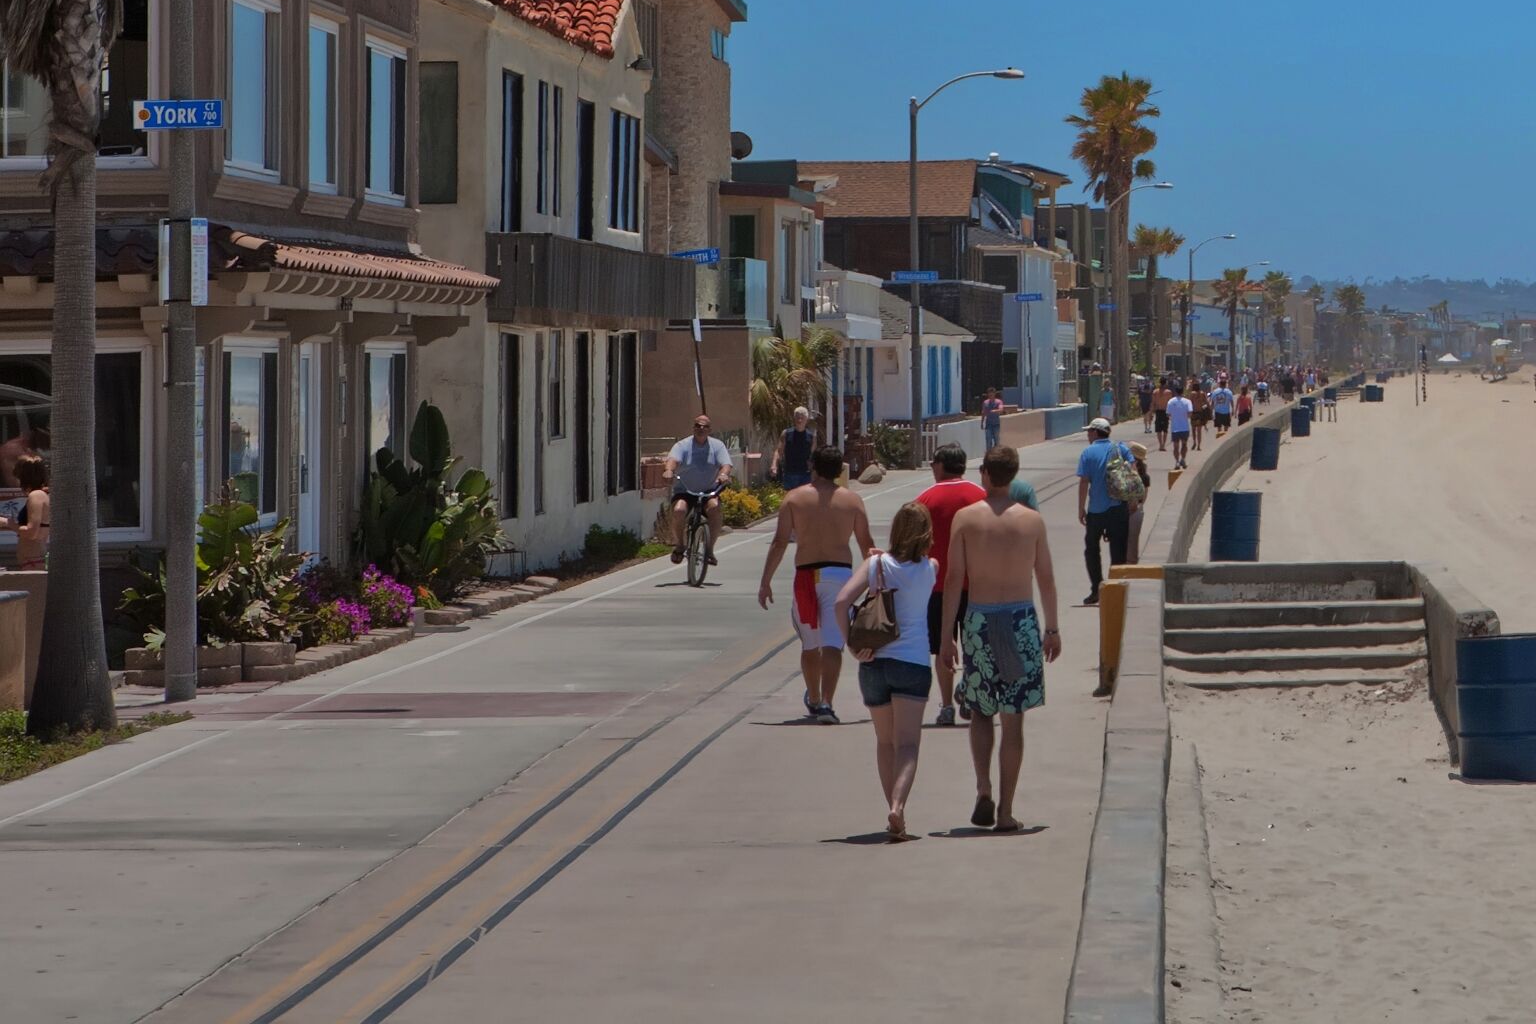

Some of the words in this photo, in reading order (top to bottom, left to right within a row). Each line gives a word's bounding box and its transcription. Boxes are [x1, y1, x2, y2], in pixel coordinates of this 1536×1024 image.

[204, 102, 215, 111] CT
[153, 105, 197, 124] YORK
[203, 111, 217, 121] 700
